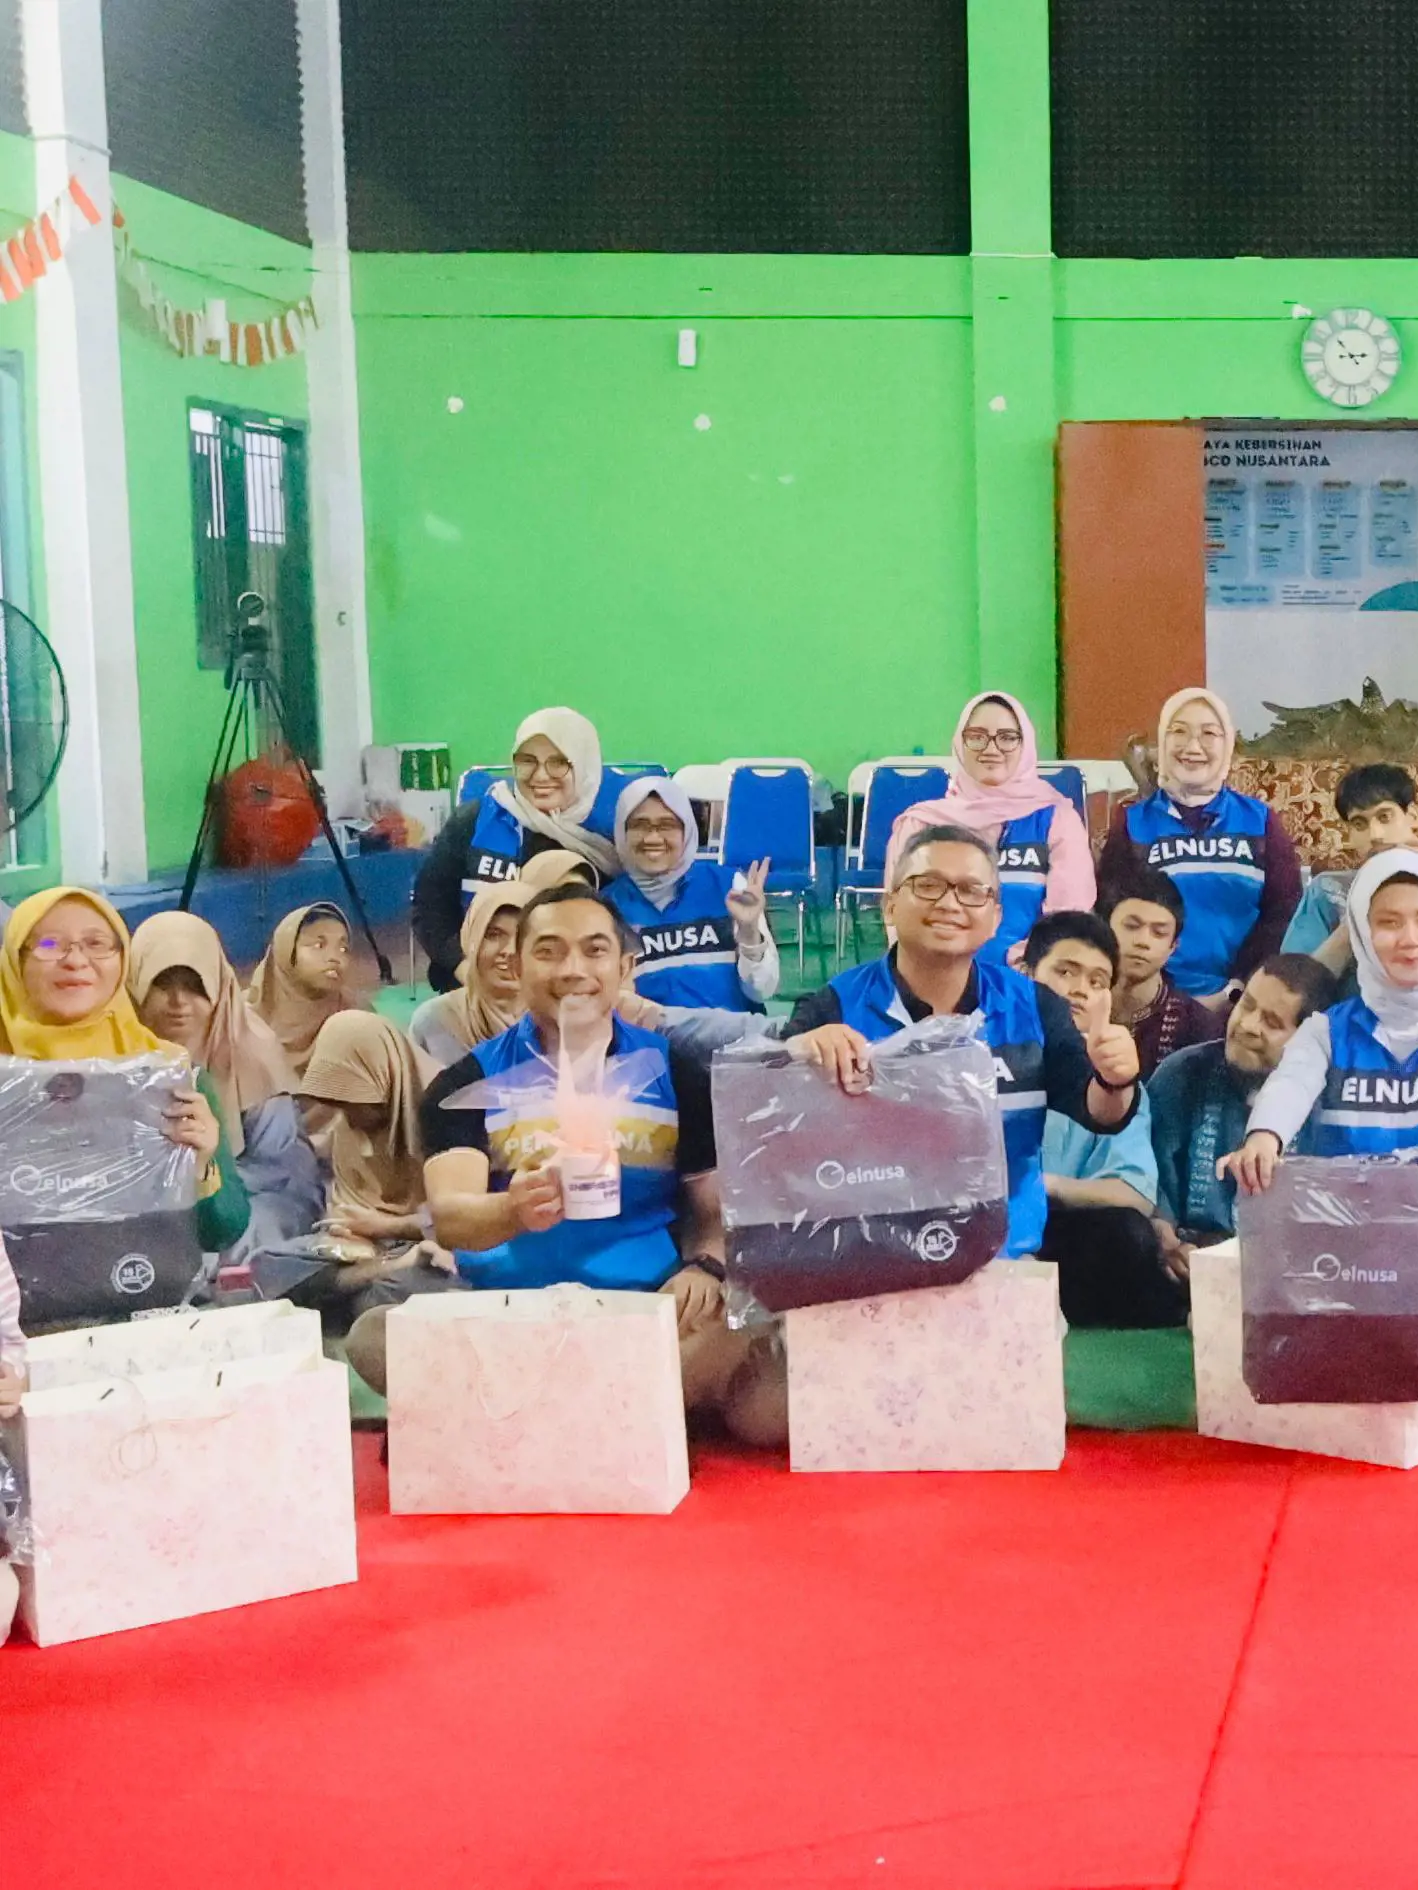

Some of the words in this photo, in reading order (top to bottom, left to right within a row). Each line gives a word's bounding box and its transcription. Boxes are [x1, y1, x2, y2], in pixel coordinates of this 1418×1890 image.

[1235, 439, 1322, 450] KEBERSIHAN
[1235, 454, 1331, 467] NUSANTARA
[1148, 838, 1253, 864] ELNUSA
[634, 924, 720, 958] NUSA
[846, 1164, 905, 1185] elnusa
[1341, 1265, 1398, 1282] elnusa
